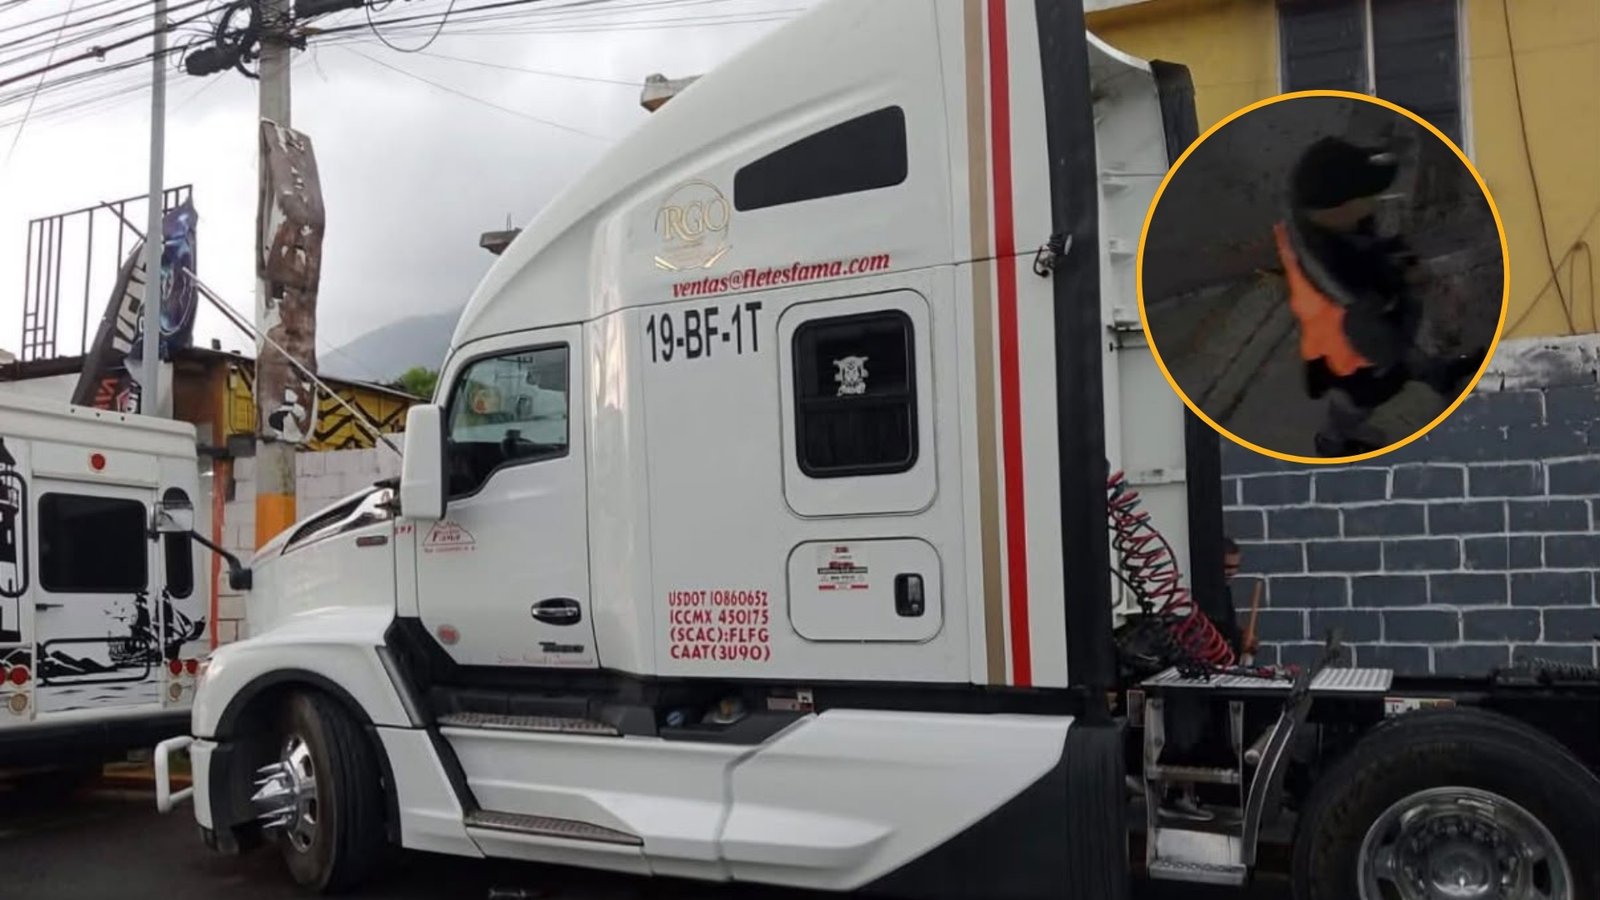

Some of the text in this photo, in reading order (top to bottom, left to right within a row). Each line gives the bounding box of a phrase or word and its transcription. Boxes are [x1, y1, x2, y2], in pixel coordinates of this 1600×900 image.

[661, 197, 731, 241] RGO
[672, 253, 890, 298] ventas@fletesfama.com
[646, 301, 763, 363] 19-BF-1T
[668, 590, 706, 606] USDOT
[670, 609, 769, 624] ICCMX 450175
[670, 626, 769, 643] (SCAC):FLFG
[670, 644, 771, 661] CAAT(3U90)
